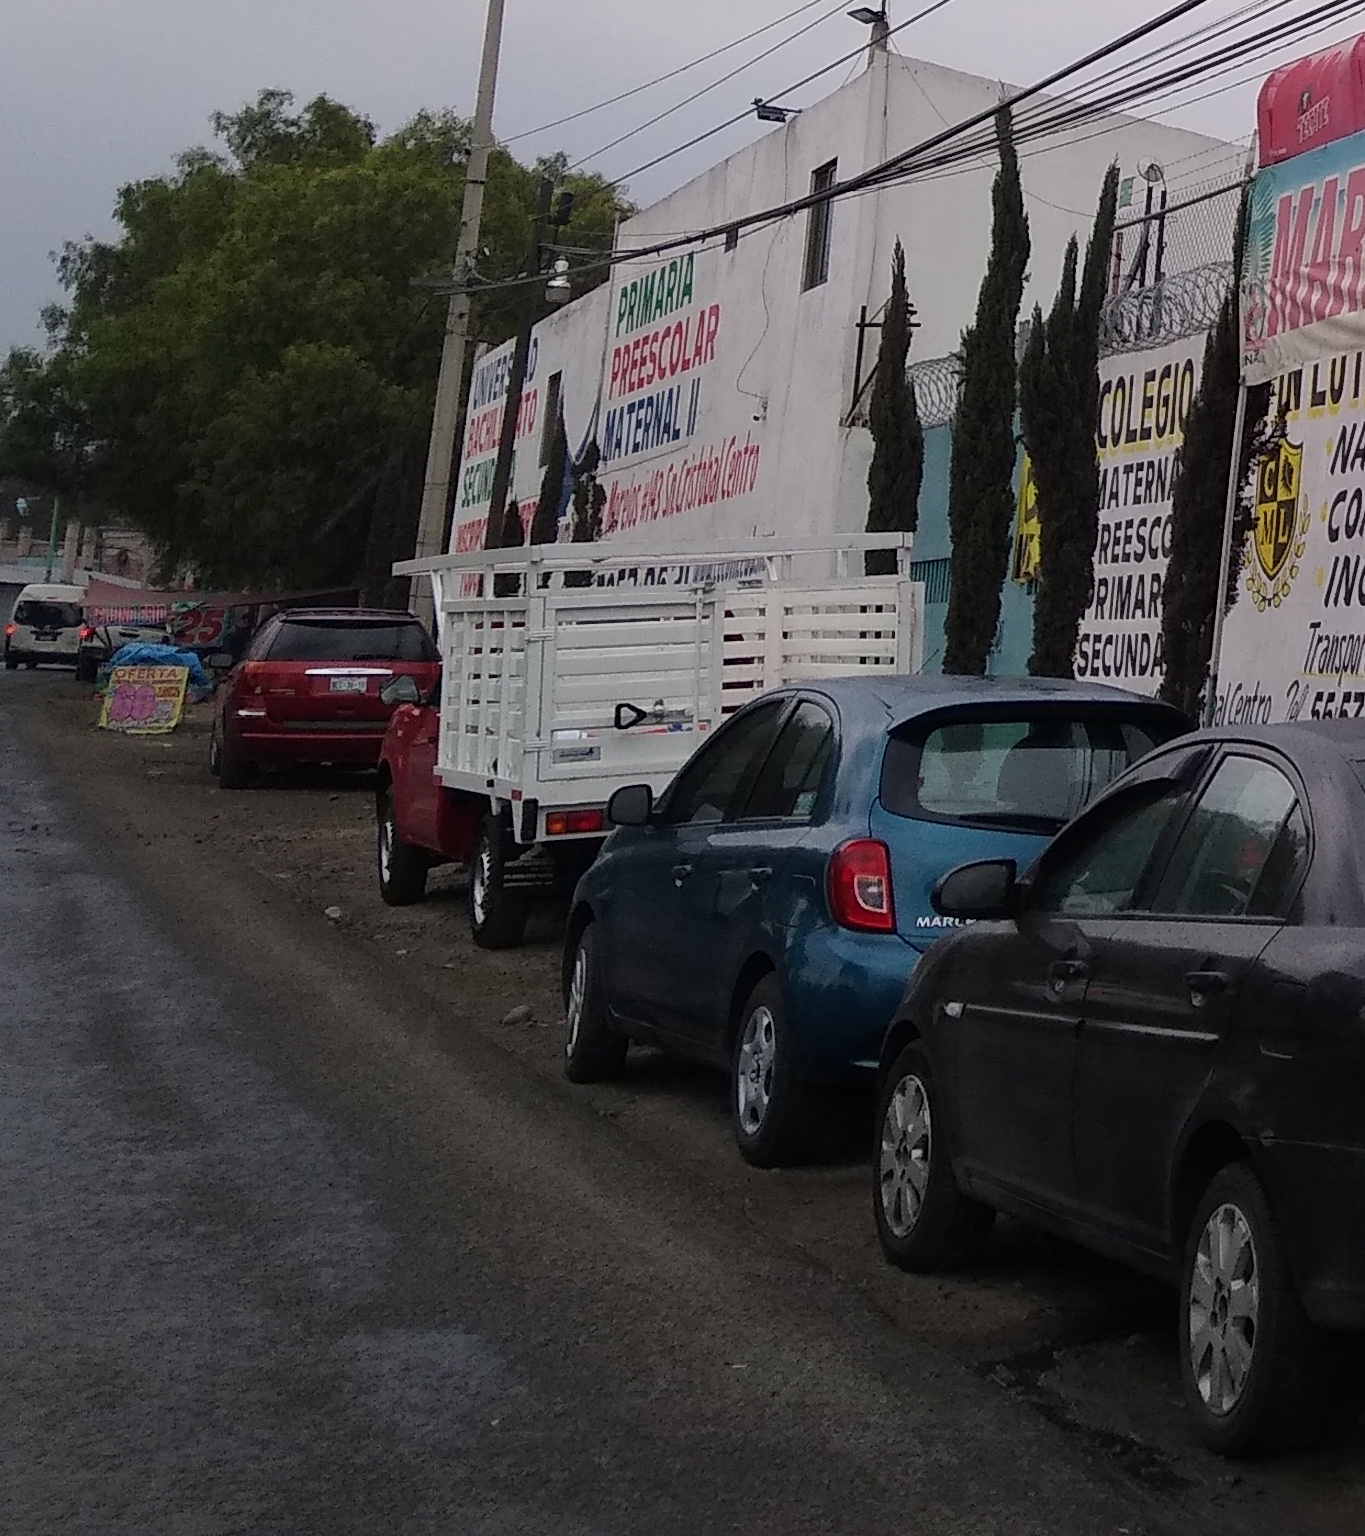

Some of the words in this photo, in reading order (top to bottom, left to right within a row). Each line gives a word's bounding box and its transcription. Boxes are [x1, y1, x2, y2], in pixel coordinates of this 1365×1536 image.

[616, 251, 694, 338] PRIMARIA
[608, 304, 720, 400] PREESCOLAR
[602, 384, 682, 462] MATERNAL
[1099, 358, 1195, 449] COLEGIO
[115, 668, 179, 680] OFERTA
